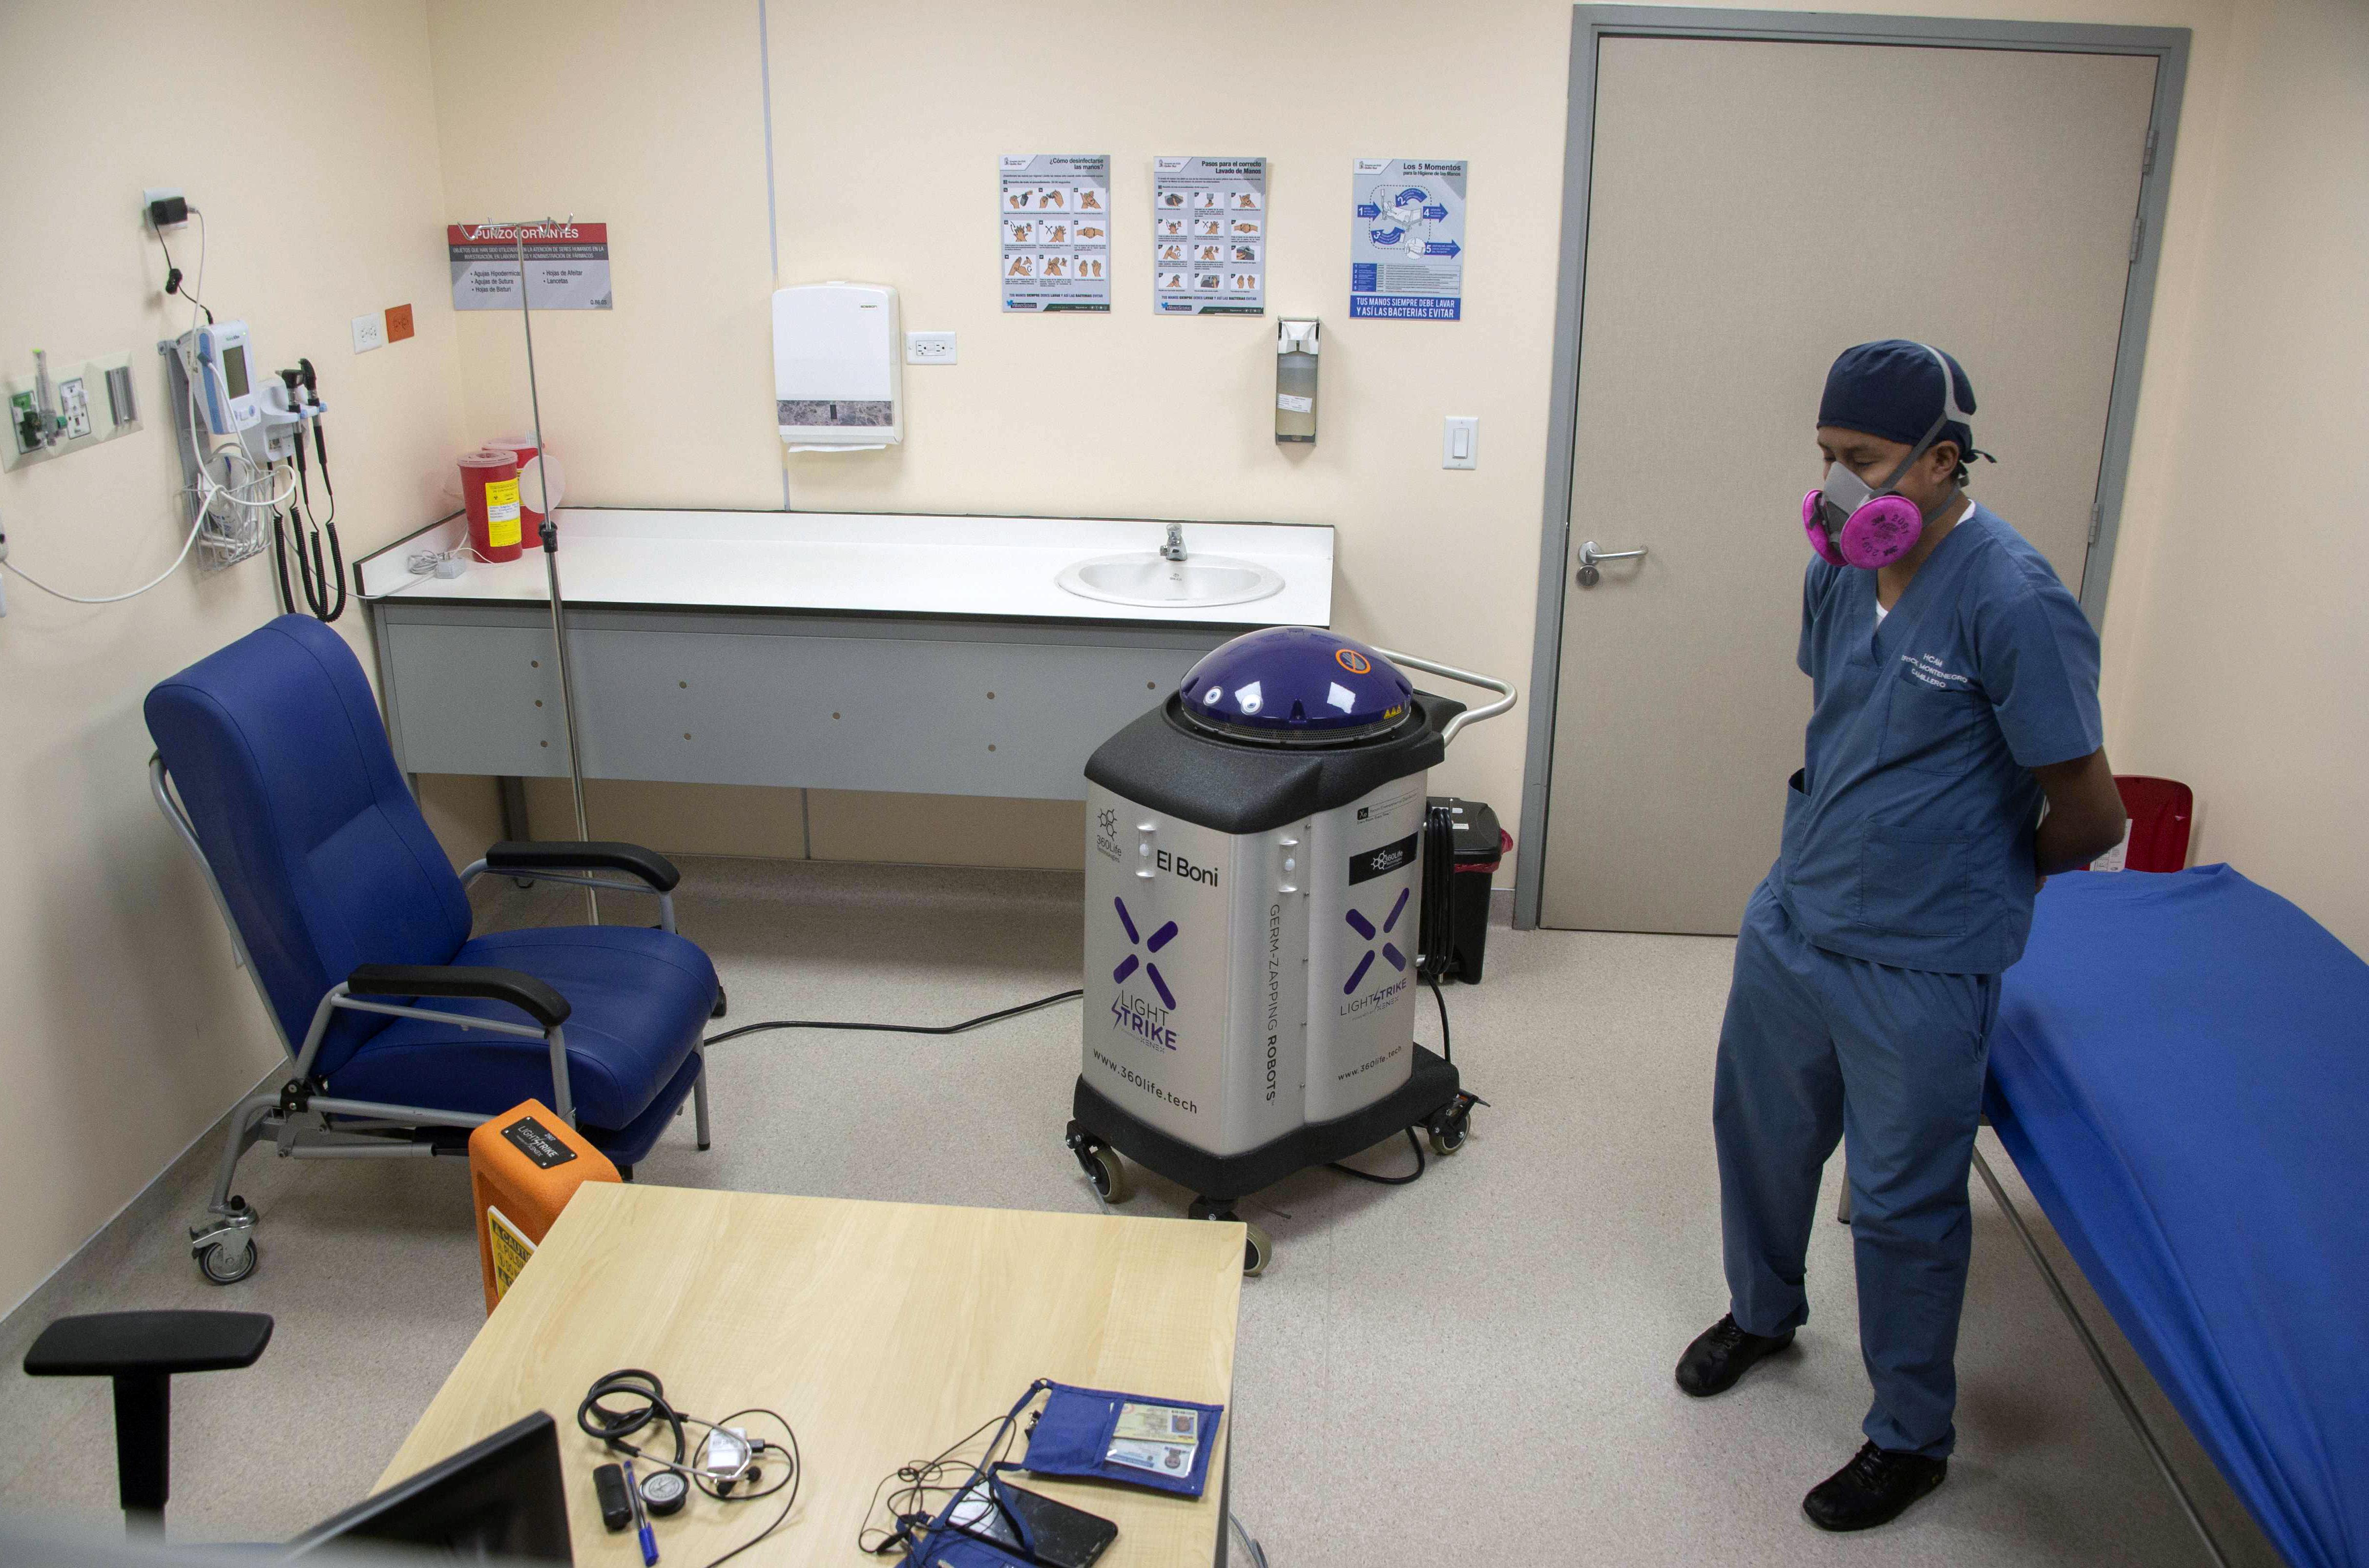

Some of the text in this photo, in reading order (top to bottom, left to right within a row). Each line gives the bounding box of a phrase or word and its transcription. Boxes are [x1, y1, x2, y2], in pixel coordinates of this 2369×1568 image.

[1424, 208, 1430, 217] 4
[1356, 306, 1454, 317] Y ASÍ LAS BACTERIAS EVITAR
[1357, 297, 1455, 308] TUS MANOS SIEMPRE DEBE LAVAR
[1923, 653, 1943, 667] HCAM
[1912, 668, 1947, 688] CAMILLERO
[1919, 663, 1968, 683] MONTENEGRO
[1097, 835, 1122, 856] 360Life
[1384, 850, 1403, 864] 360Life
[1157, 849, 1218, 887] El Boni
[1122, 990, 1169, 1026] LIGHT
[1266, 904, 1280, 1101] GERM-ZAPPING ROBOTS
[1140, 1037, 1165, 1054] XENEX
[1338, 1046, 1401, 1081] www.360life.tech
[1093, 1049, 1197, 1114] www.360life.tech
